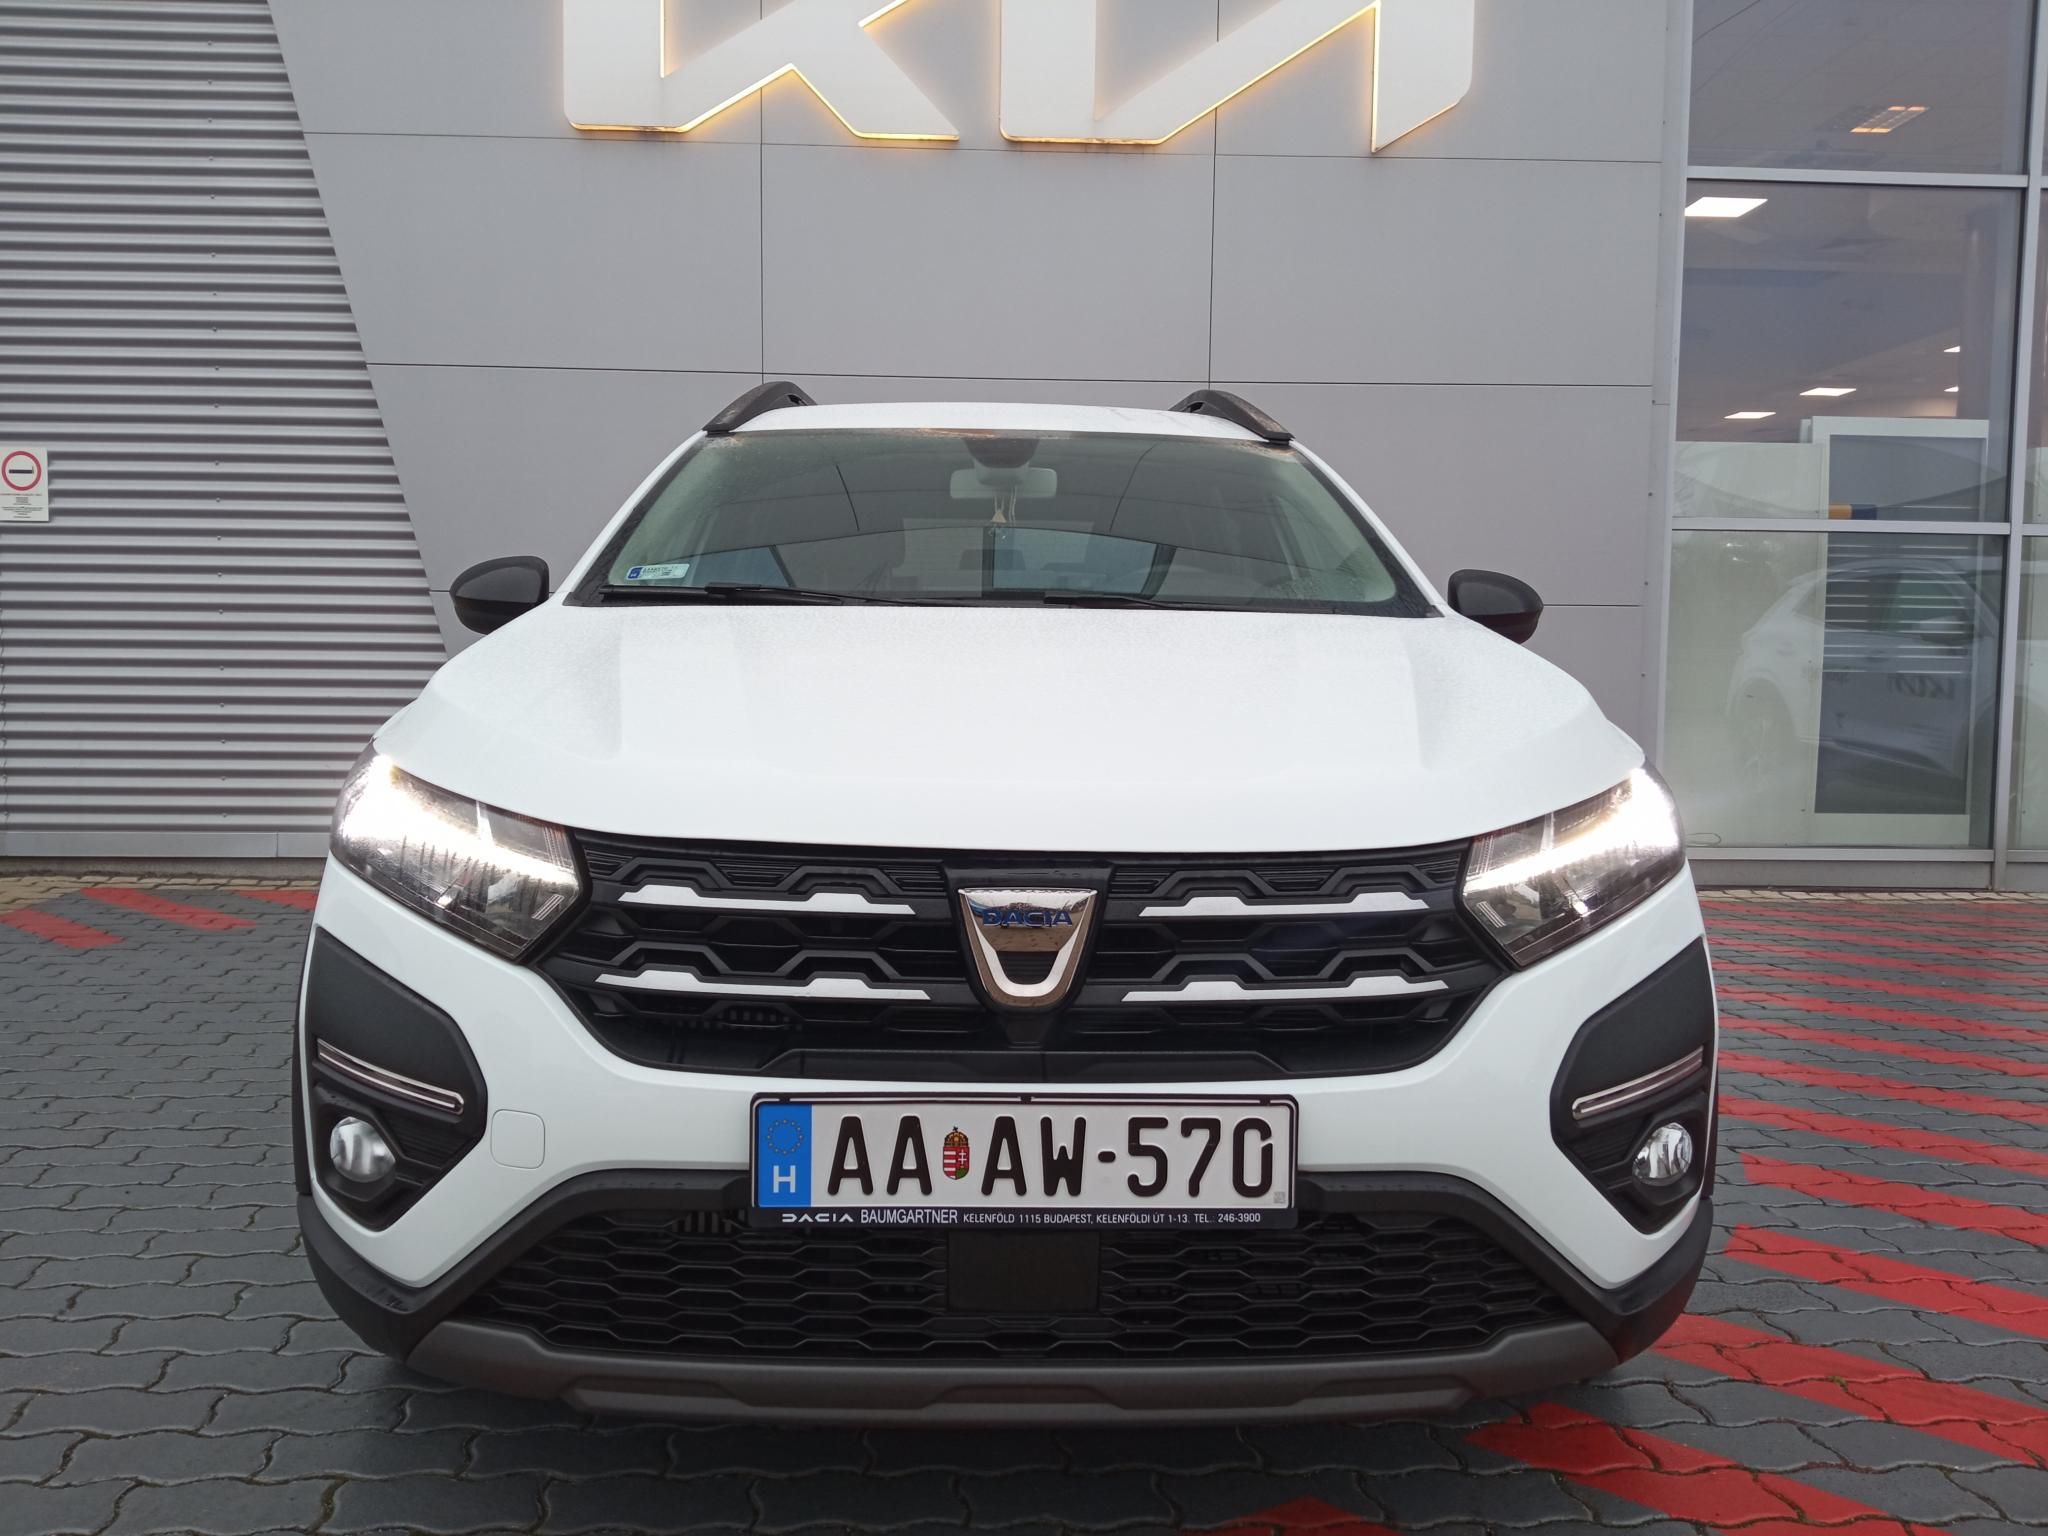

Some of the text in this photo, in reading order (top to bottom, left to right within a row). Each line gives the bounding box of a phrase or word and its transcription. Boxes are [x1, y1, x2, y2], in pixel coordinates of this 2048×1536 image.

[983, 909, 1073, 928] DACIA
[827, 1115, 1274, 1198] AA AW-570
[773, 1165, 796, 1193] H
[782, 1213, 854, 1223] DACIA
[860, 1209, 958, 1224] BAUMGARTNER
[963, 1211, 1015, 1224] KELENFÖLD
[1020, 1213, 1042, 1224] 1115
[1043, 1213, 1094, 1225] BUDAPEST,
[1217, 1212, 1261, 1223] 246-3900
